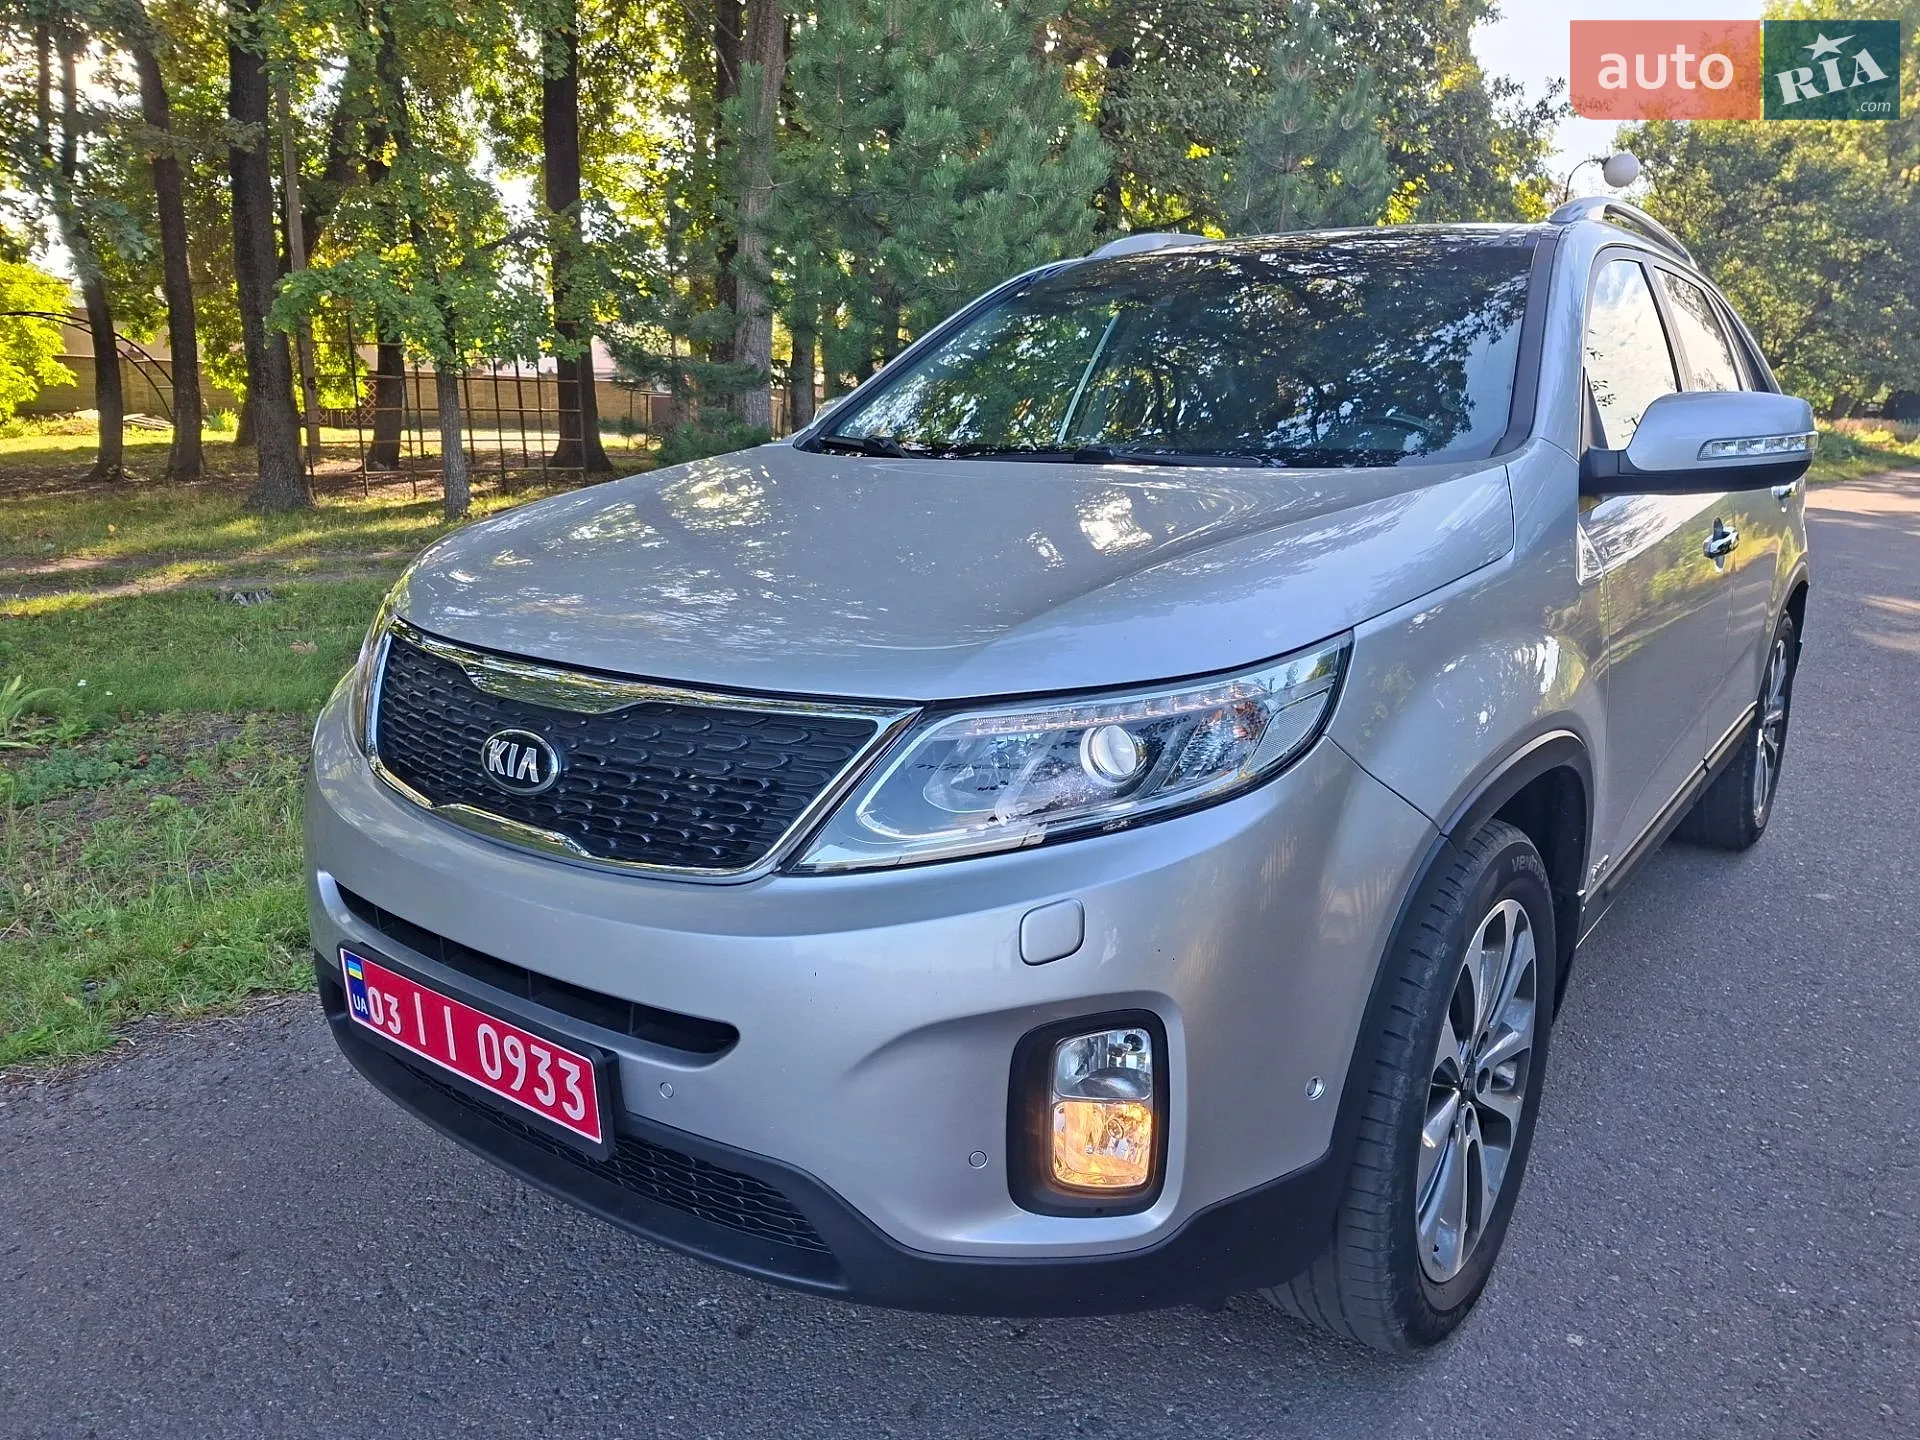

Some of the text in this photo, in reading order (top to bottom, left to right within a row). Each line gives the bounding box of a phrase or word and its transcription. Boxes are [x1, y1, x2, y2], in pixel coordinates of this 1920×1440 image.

[488, 738, 540, 783] KIA
[352, 993, 369, 1015] UA
[476, 1022, 586, 1121] 0933
